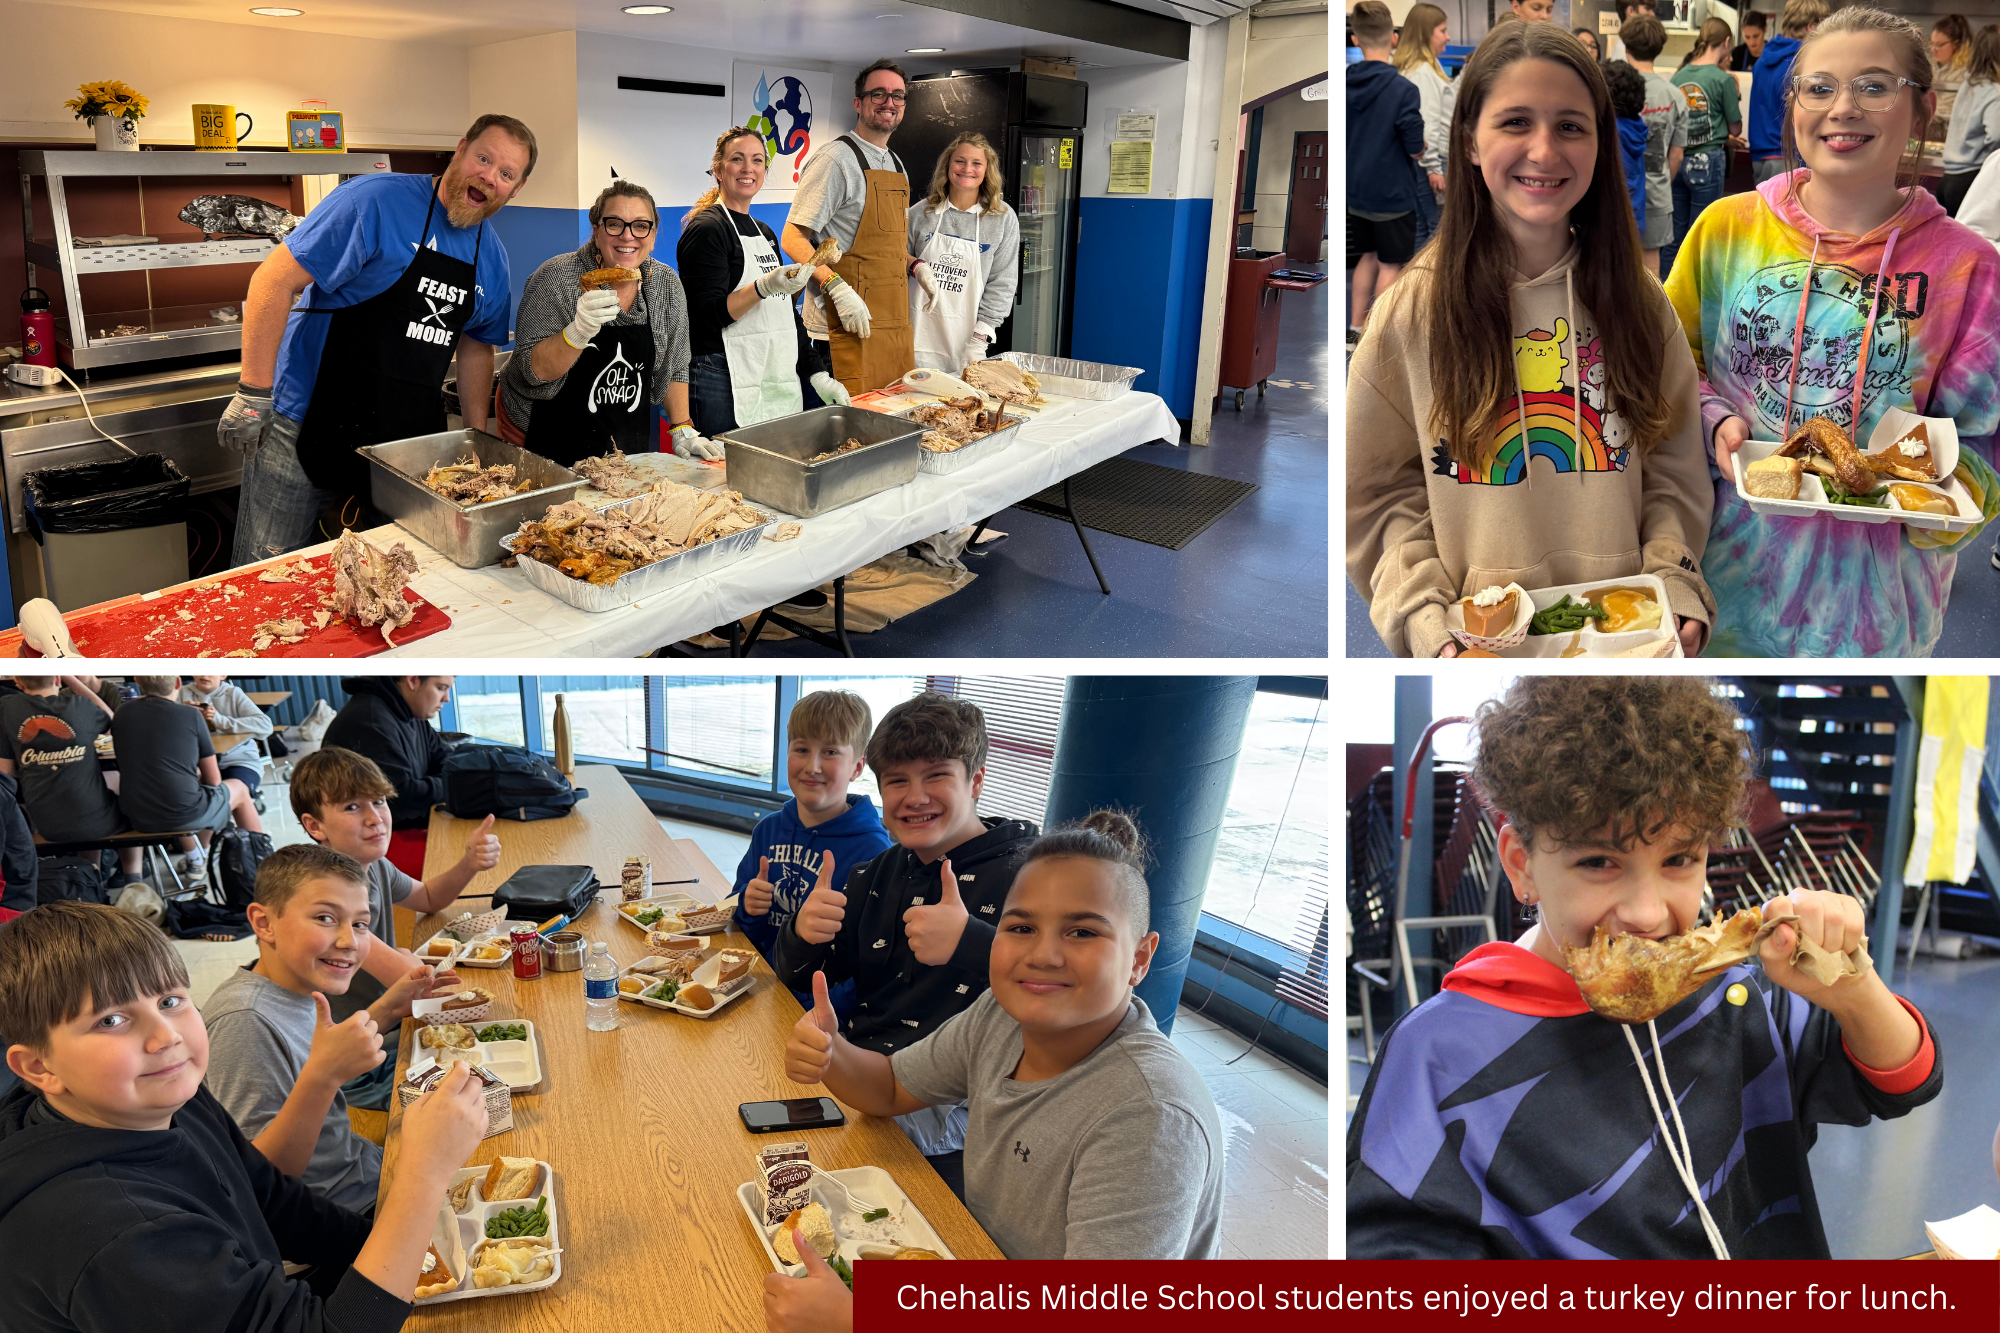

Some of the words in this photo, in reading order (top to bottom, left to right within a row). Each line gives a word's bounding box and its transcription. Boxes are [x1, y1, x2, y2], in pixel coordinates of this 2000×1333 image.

[201, 115, 224, 128] BIG
[202, 129, 225, 137] DEAL
[417, 276, 468, 305] FEAST
[1857, 271, 1928, 321] SD
[1736, 271, 1824, 342] BLACK
[405, 321, 454, 346] MODE
[606, 366, 629, 386] OH
[596, 384, 637, 404] SNAP
[21, 745, 86, 765] Columbia
[979, 903, 997, 915] nike
[773, 1170, 808, 1187] DARIGOLD
